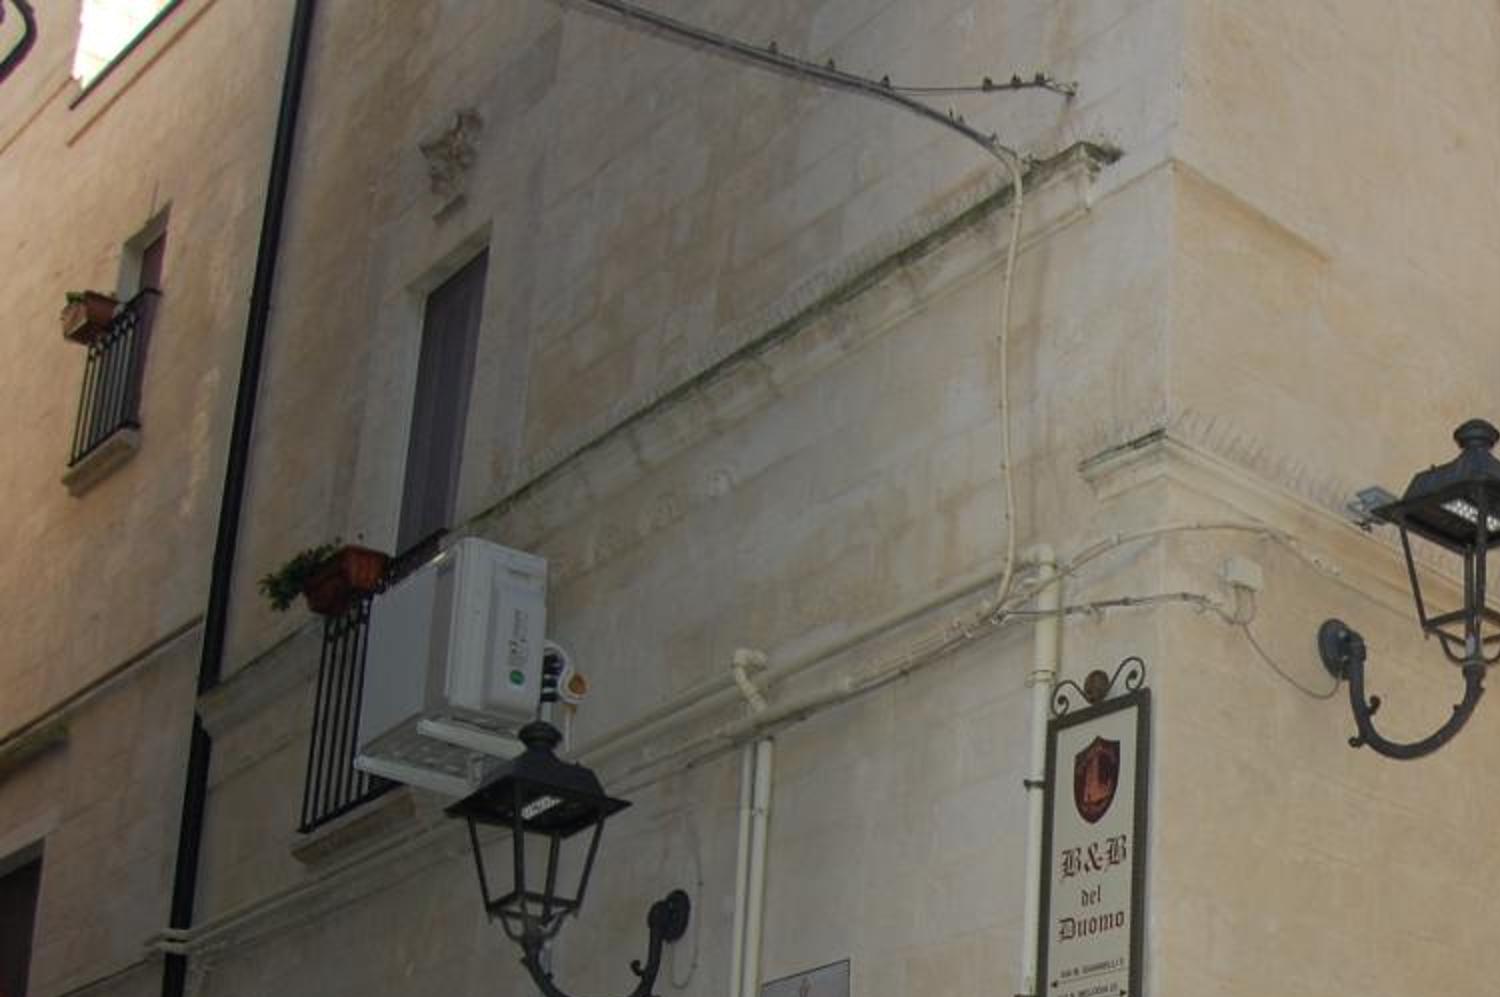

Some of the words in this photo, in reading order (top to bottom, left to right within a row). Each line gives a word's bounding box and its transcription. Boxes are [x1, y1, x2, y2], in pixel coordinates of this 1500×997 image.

[1060, 834, 1128, 879] B&B
[1081, 884, 1101, 906] del
[1057, 911, 1125, 942] Duomo
